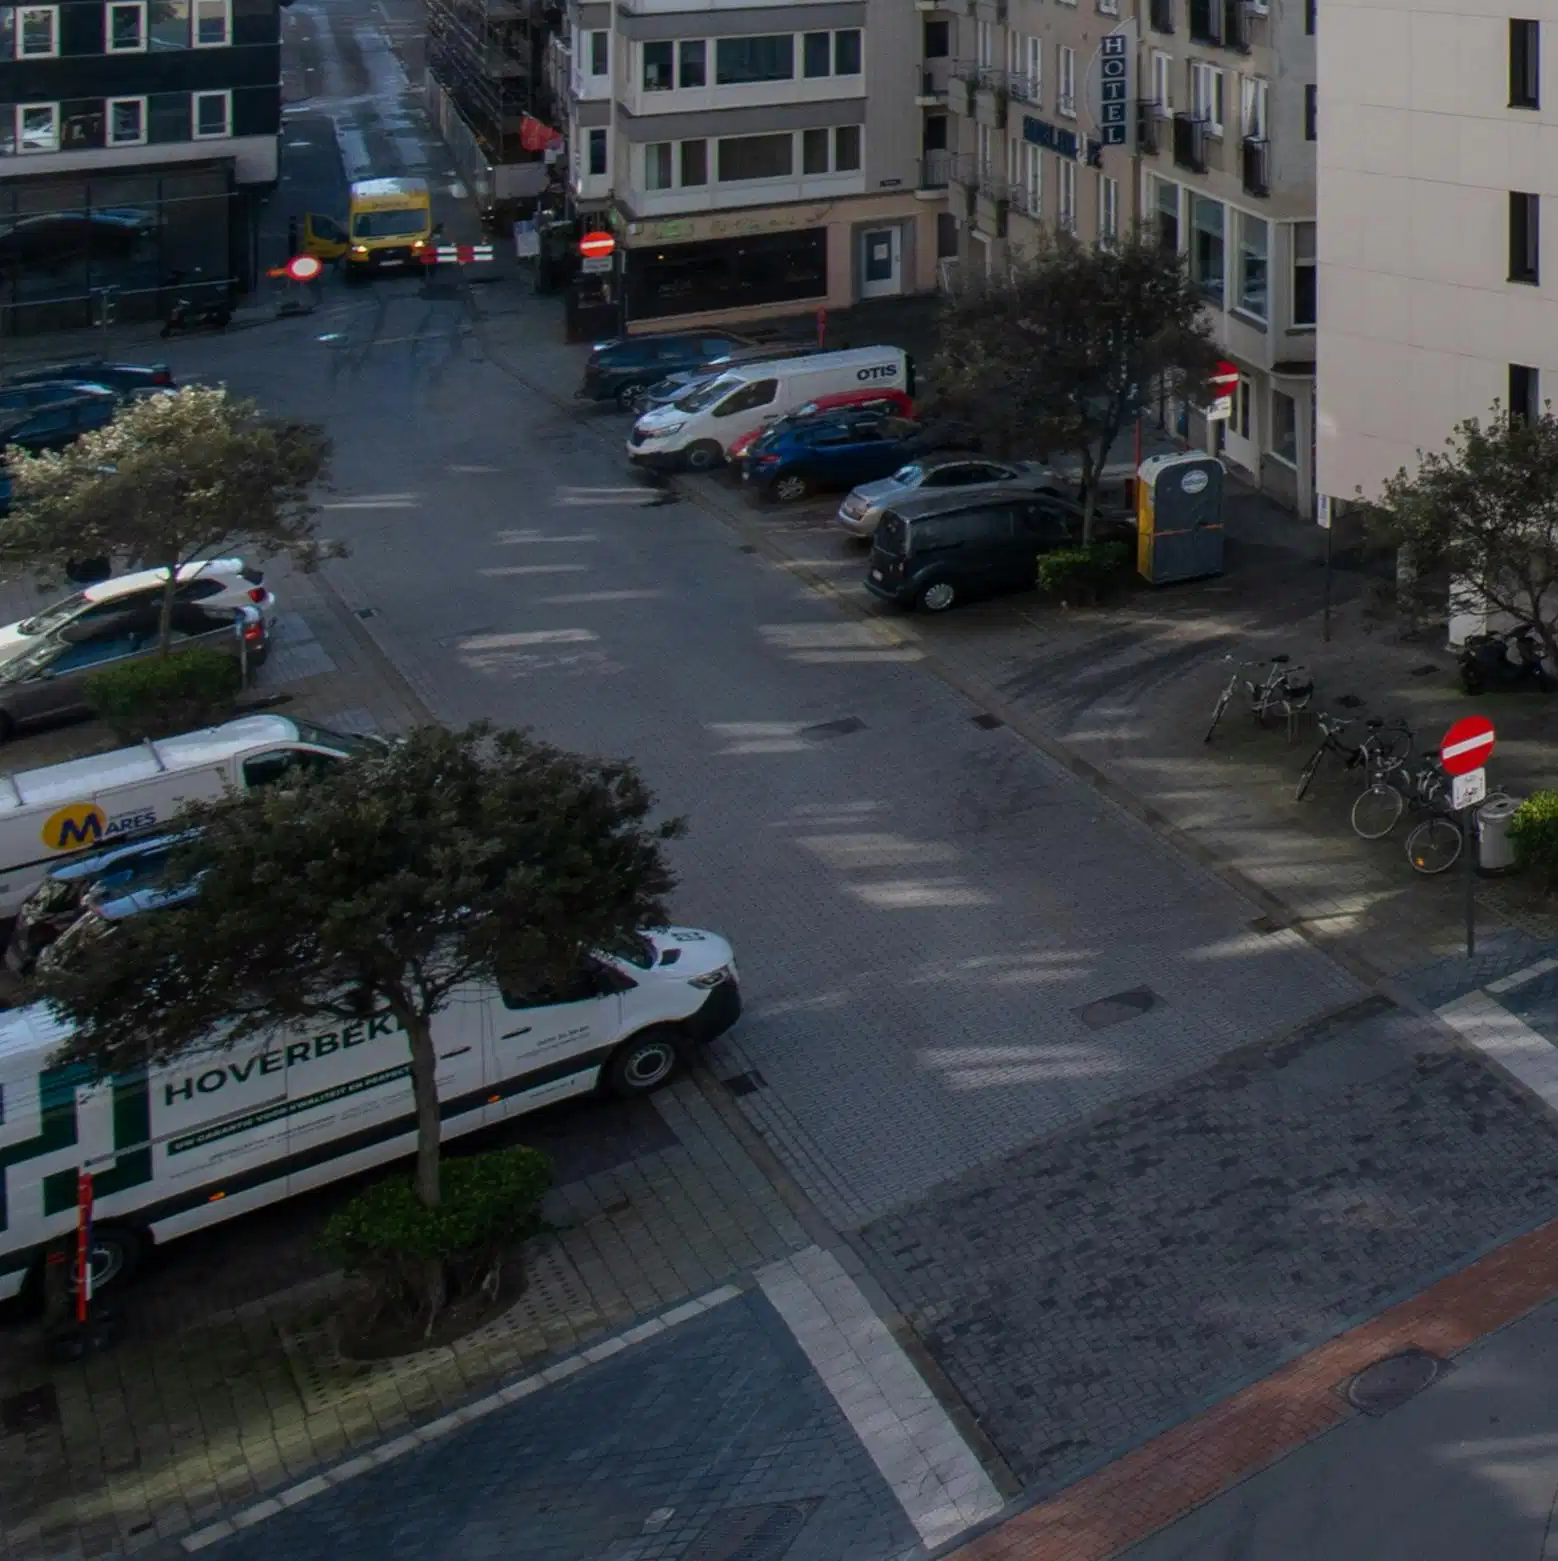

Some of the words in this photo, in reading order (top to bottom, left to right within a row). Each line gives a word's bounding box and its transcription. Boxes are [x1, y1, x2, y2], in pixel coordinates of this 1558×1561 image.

[1104, 37, 1124, 143] HOTEL
[856, 363, 897, 381] OTIS
[58, 811, 157, 846] MARES
[163, 1013, 407, 1107] HOVERBEK
